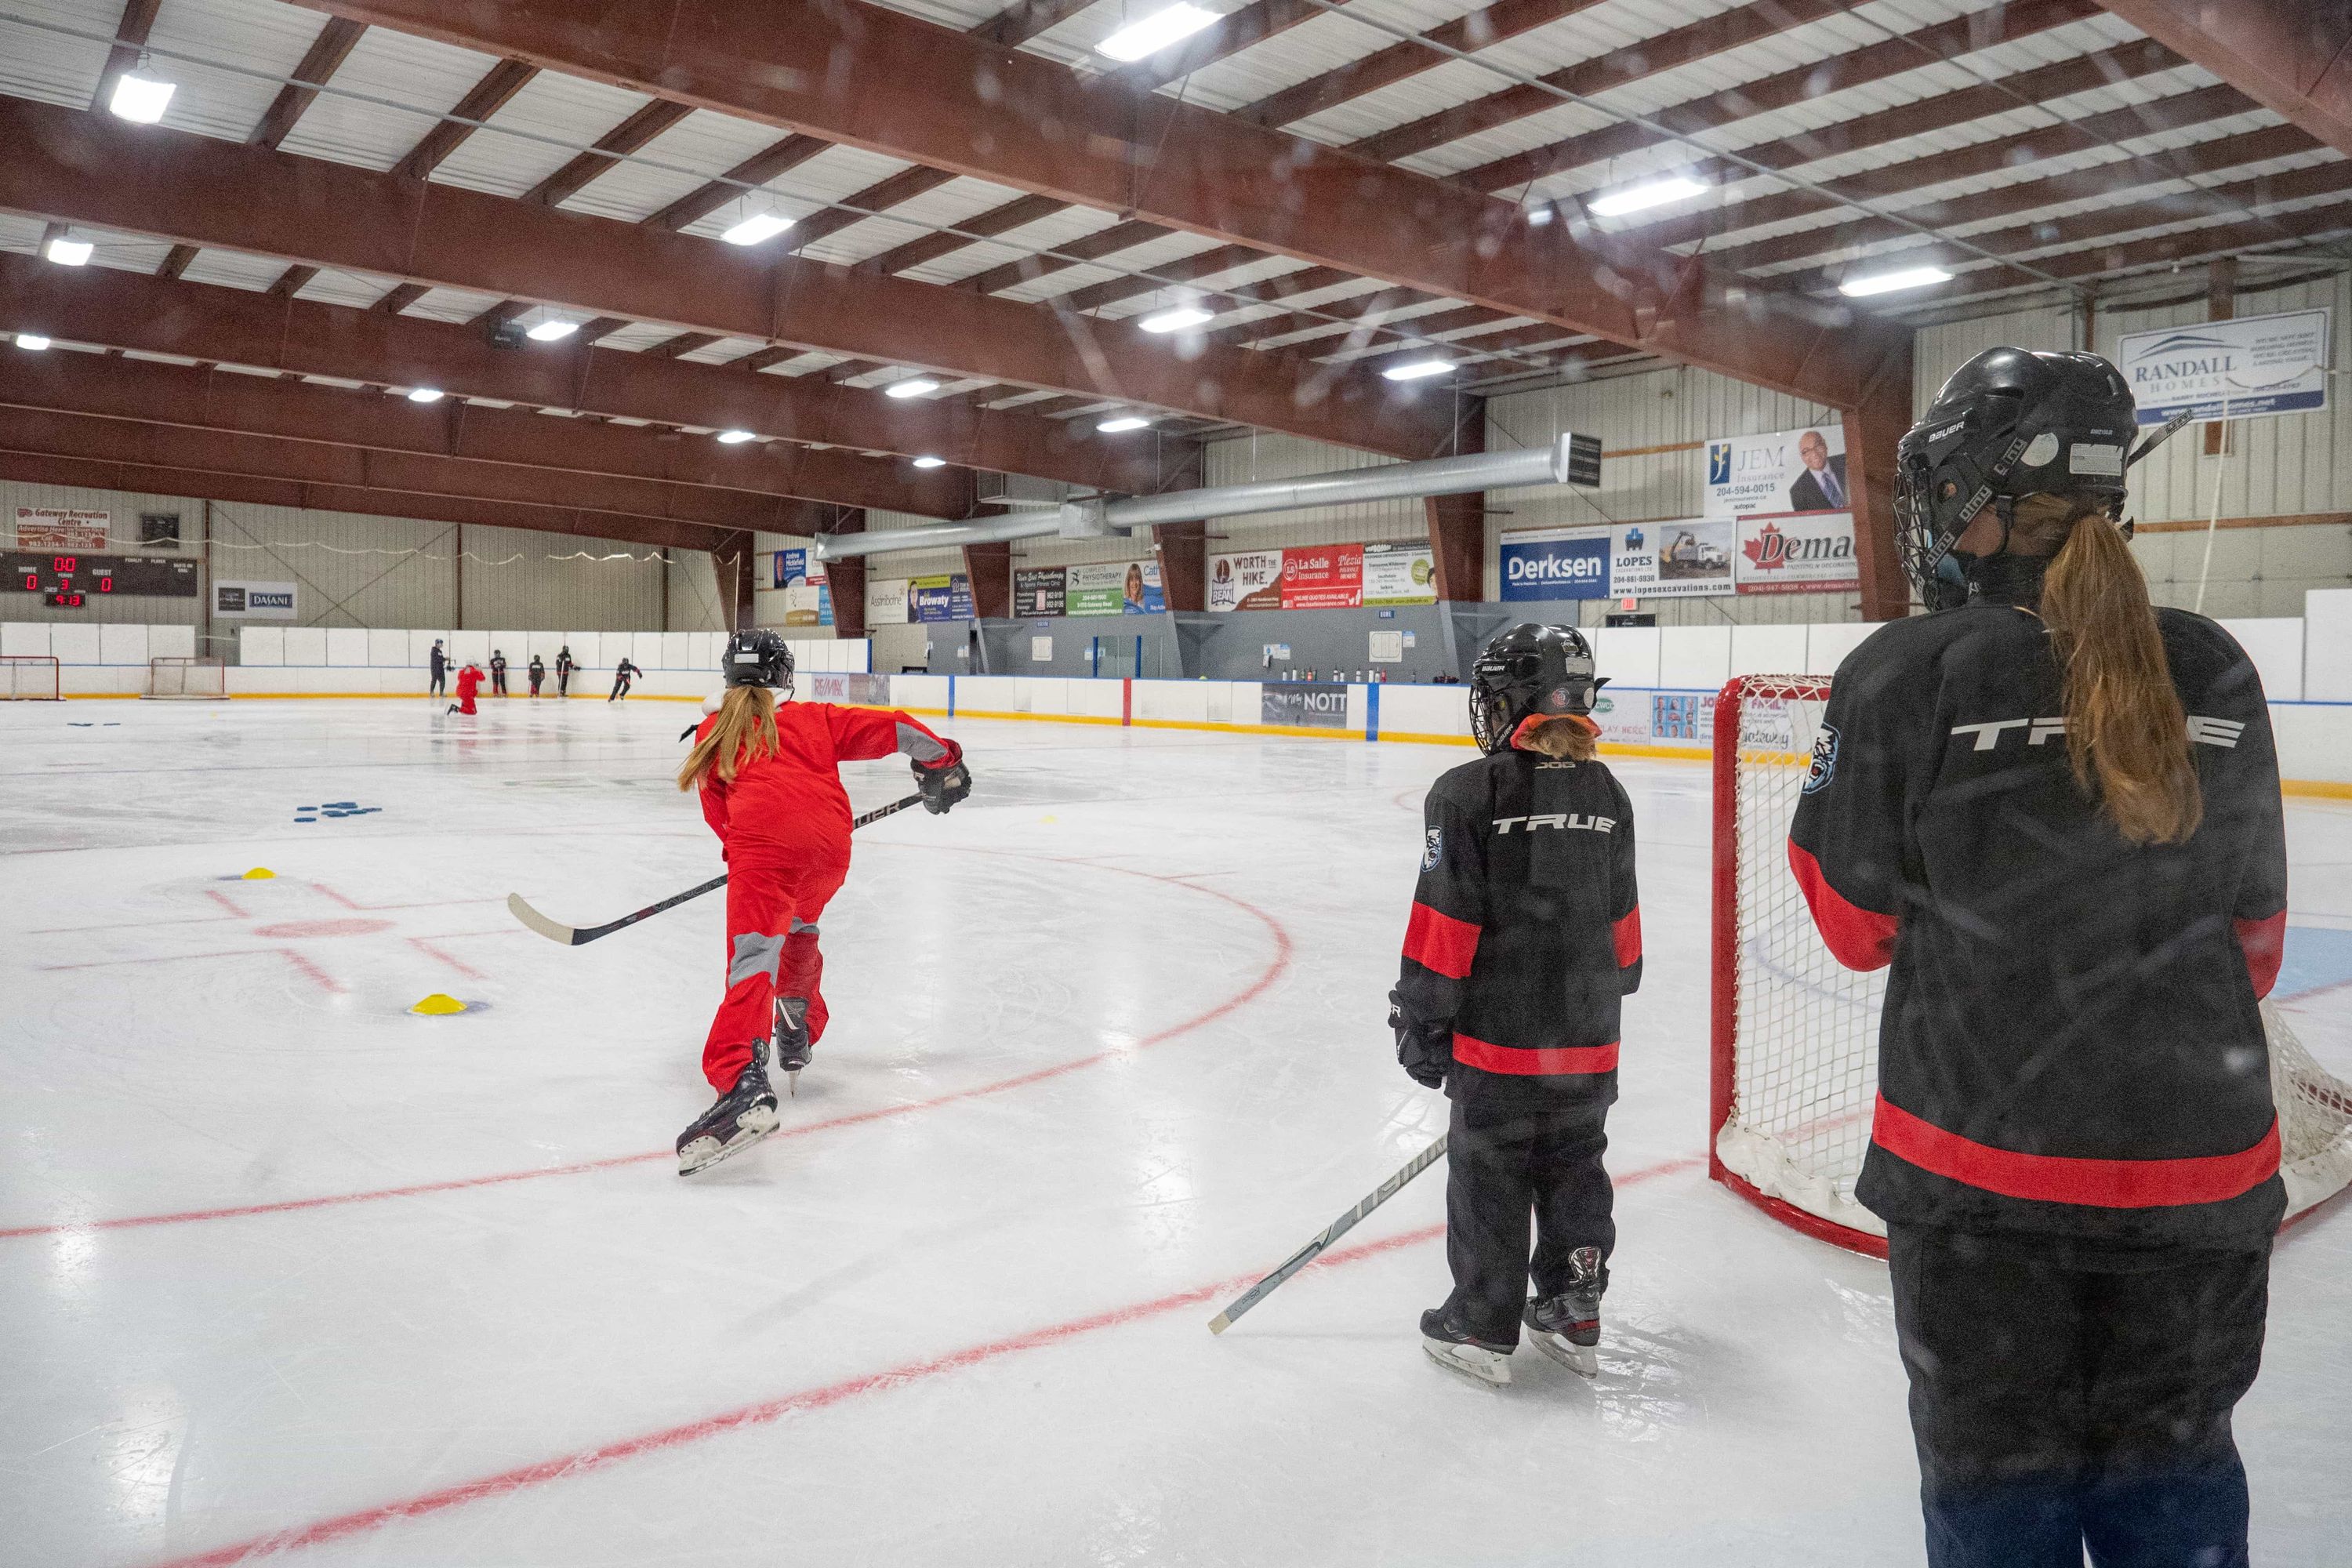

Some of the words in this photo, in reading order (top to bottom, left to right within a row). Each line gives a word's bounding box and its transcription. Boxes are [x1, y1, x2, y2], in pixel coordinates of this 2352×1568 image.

[2135, 356, 2237, 383] RANDALL
[2151, 377, 2220, 392] HOMES
[1929, 422, 1965, 442] BAUER
[1737, 446, 1785, 471] JEM
[1737, 472, 1785, 482] Insurance
[1716, 483, 1775, 496] 204-594-0015
[35, 509, 67, 517] Gateway
[69, 510, 107, 519] Recreation
[1759, 534, 1857, 561] Dema
[1234, 556, 1266, 569] WORTH
[1299, 560, 1308, 570] La
[1310, 557, 1330, 569] Salle
[1509, 554, 1601, 579] Derksen
[1616, 556, 1652, 567] LOPES
[27, 575, 37, 590] 0
[1083, 572, 1122, 581] PHYSIOTHERAPY
[1243, 572, 1268, 586] HIKE.
[61, 579, 69, 590] 3
[101, 577, 112, 592] 0
[1613, 583, 1731, 595] www.lopesexcavations.com
[254, 596, 288, 605] DASANI
[920, 596, 949, 608] Browaty
[1213, 590, 1232, 601] BEAN
[815, 678, 844, 697] RE/MAX
[1305, 693, 1346, 711] NOTT
[1493, 814, 1617, 834] TRUE
